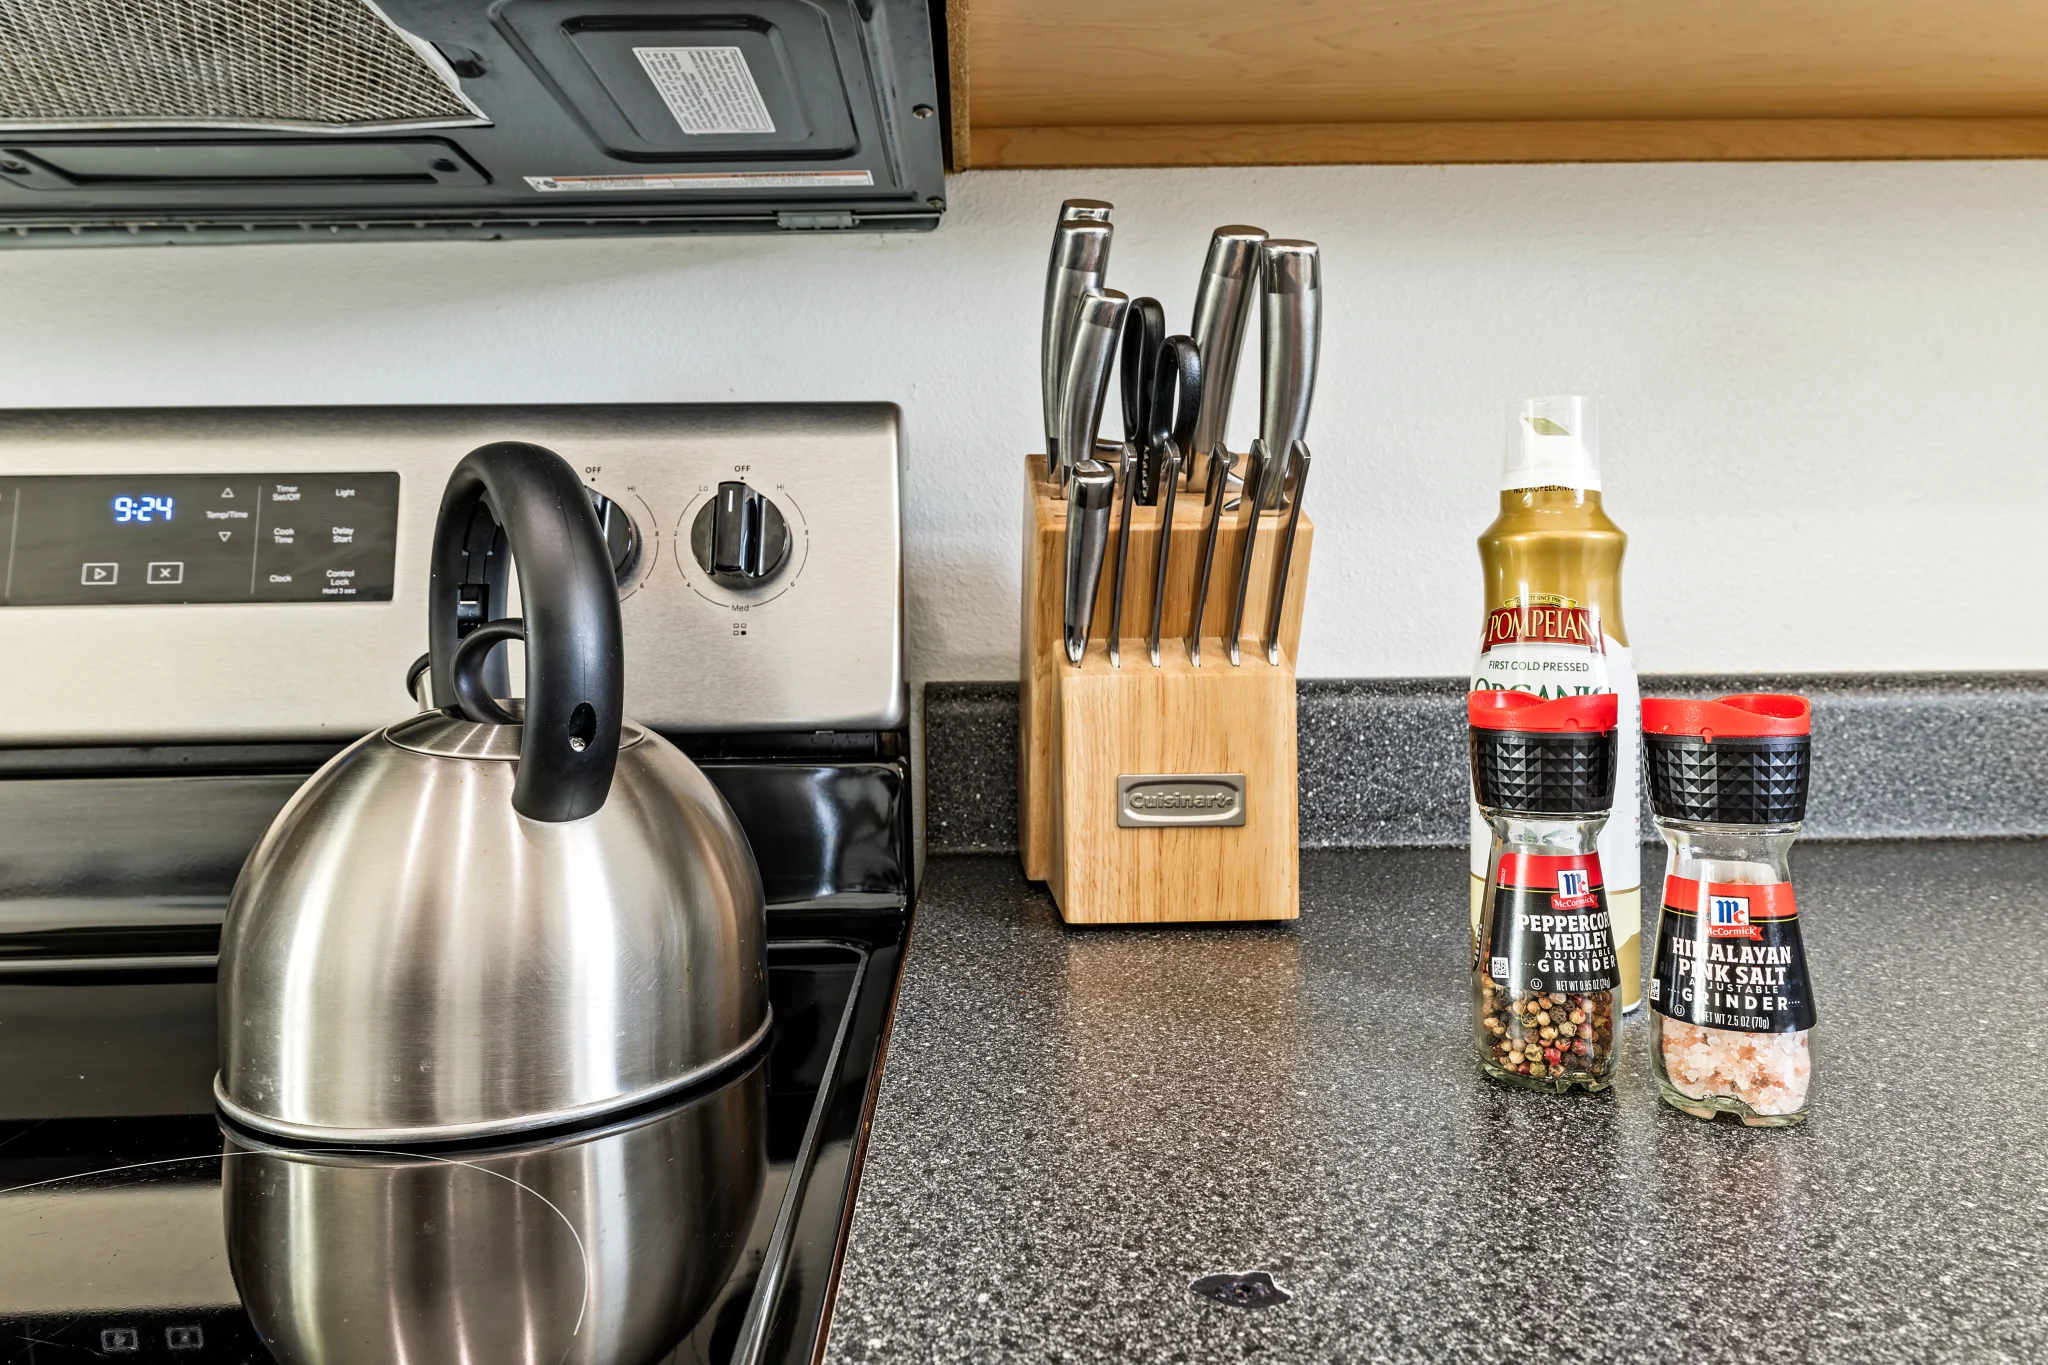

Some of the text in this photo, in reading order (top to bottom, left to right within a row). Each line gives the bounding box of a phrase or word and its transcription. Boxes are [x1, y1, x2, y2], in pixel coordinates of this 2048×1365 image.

[585, 466, 602, 474] OFF
[734, 465, 751, 473] OFF
[335, 488, 356, 498] Light
[627, 485, 636, 493] Hi
[699, 484, 709, 492] Lo
[776, 483, 785, 491] Hi
[272, 493, 301, 501] Set/Off
[114, 497, 173, 521] 9:24
[206, 510, 248, 520] Temp/Time
[332, 526, 354, 536] Delay
[333, 535, 352, 543] Start
[731, 604, 749, 612] Med
[1488, 609, 1598, 642] POMPEIAN
[1488, 660, 1589, 672] FIRST COLD PRESSED
[1130, 792, 1226, 809] Cuisinart
[1553, 895, 1595, 907] McCormick
[1518, 911, 1611, 932] PEPPERCOR
[1705, 926, 1757, 936] McCormick
[1544, 930, 1608, 950] MEDLEY
[1544, 947, 1610, 959] ADJUSTABLE
[1538, 955, 1615, 972] GRINDER
[1736, 966, 1786, 985] SALT
[1556, 980, 1567, 991] NET
[1569, 980, 1579, 991] WT
[1580, 980, 1592, 991] 0.85
[1593, 979, 1600, 990] OZ
[1682, 988, 1788, 1011] GRINDER
[1714, 1013, 1725, 1024] WT
[1727, 1015, 1739, 1027] 2.5
[1741, 1016, 1750, 1028] OZ
[1752, 1016, 1770, 1029] (70g)
